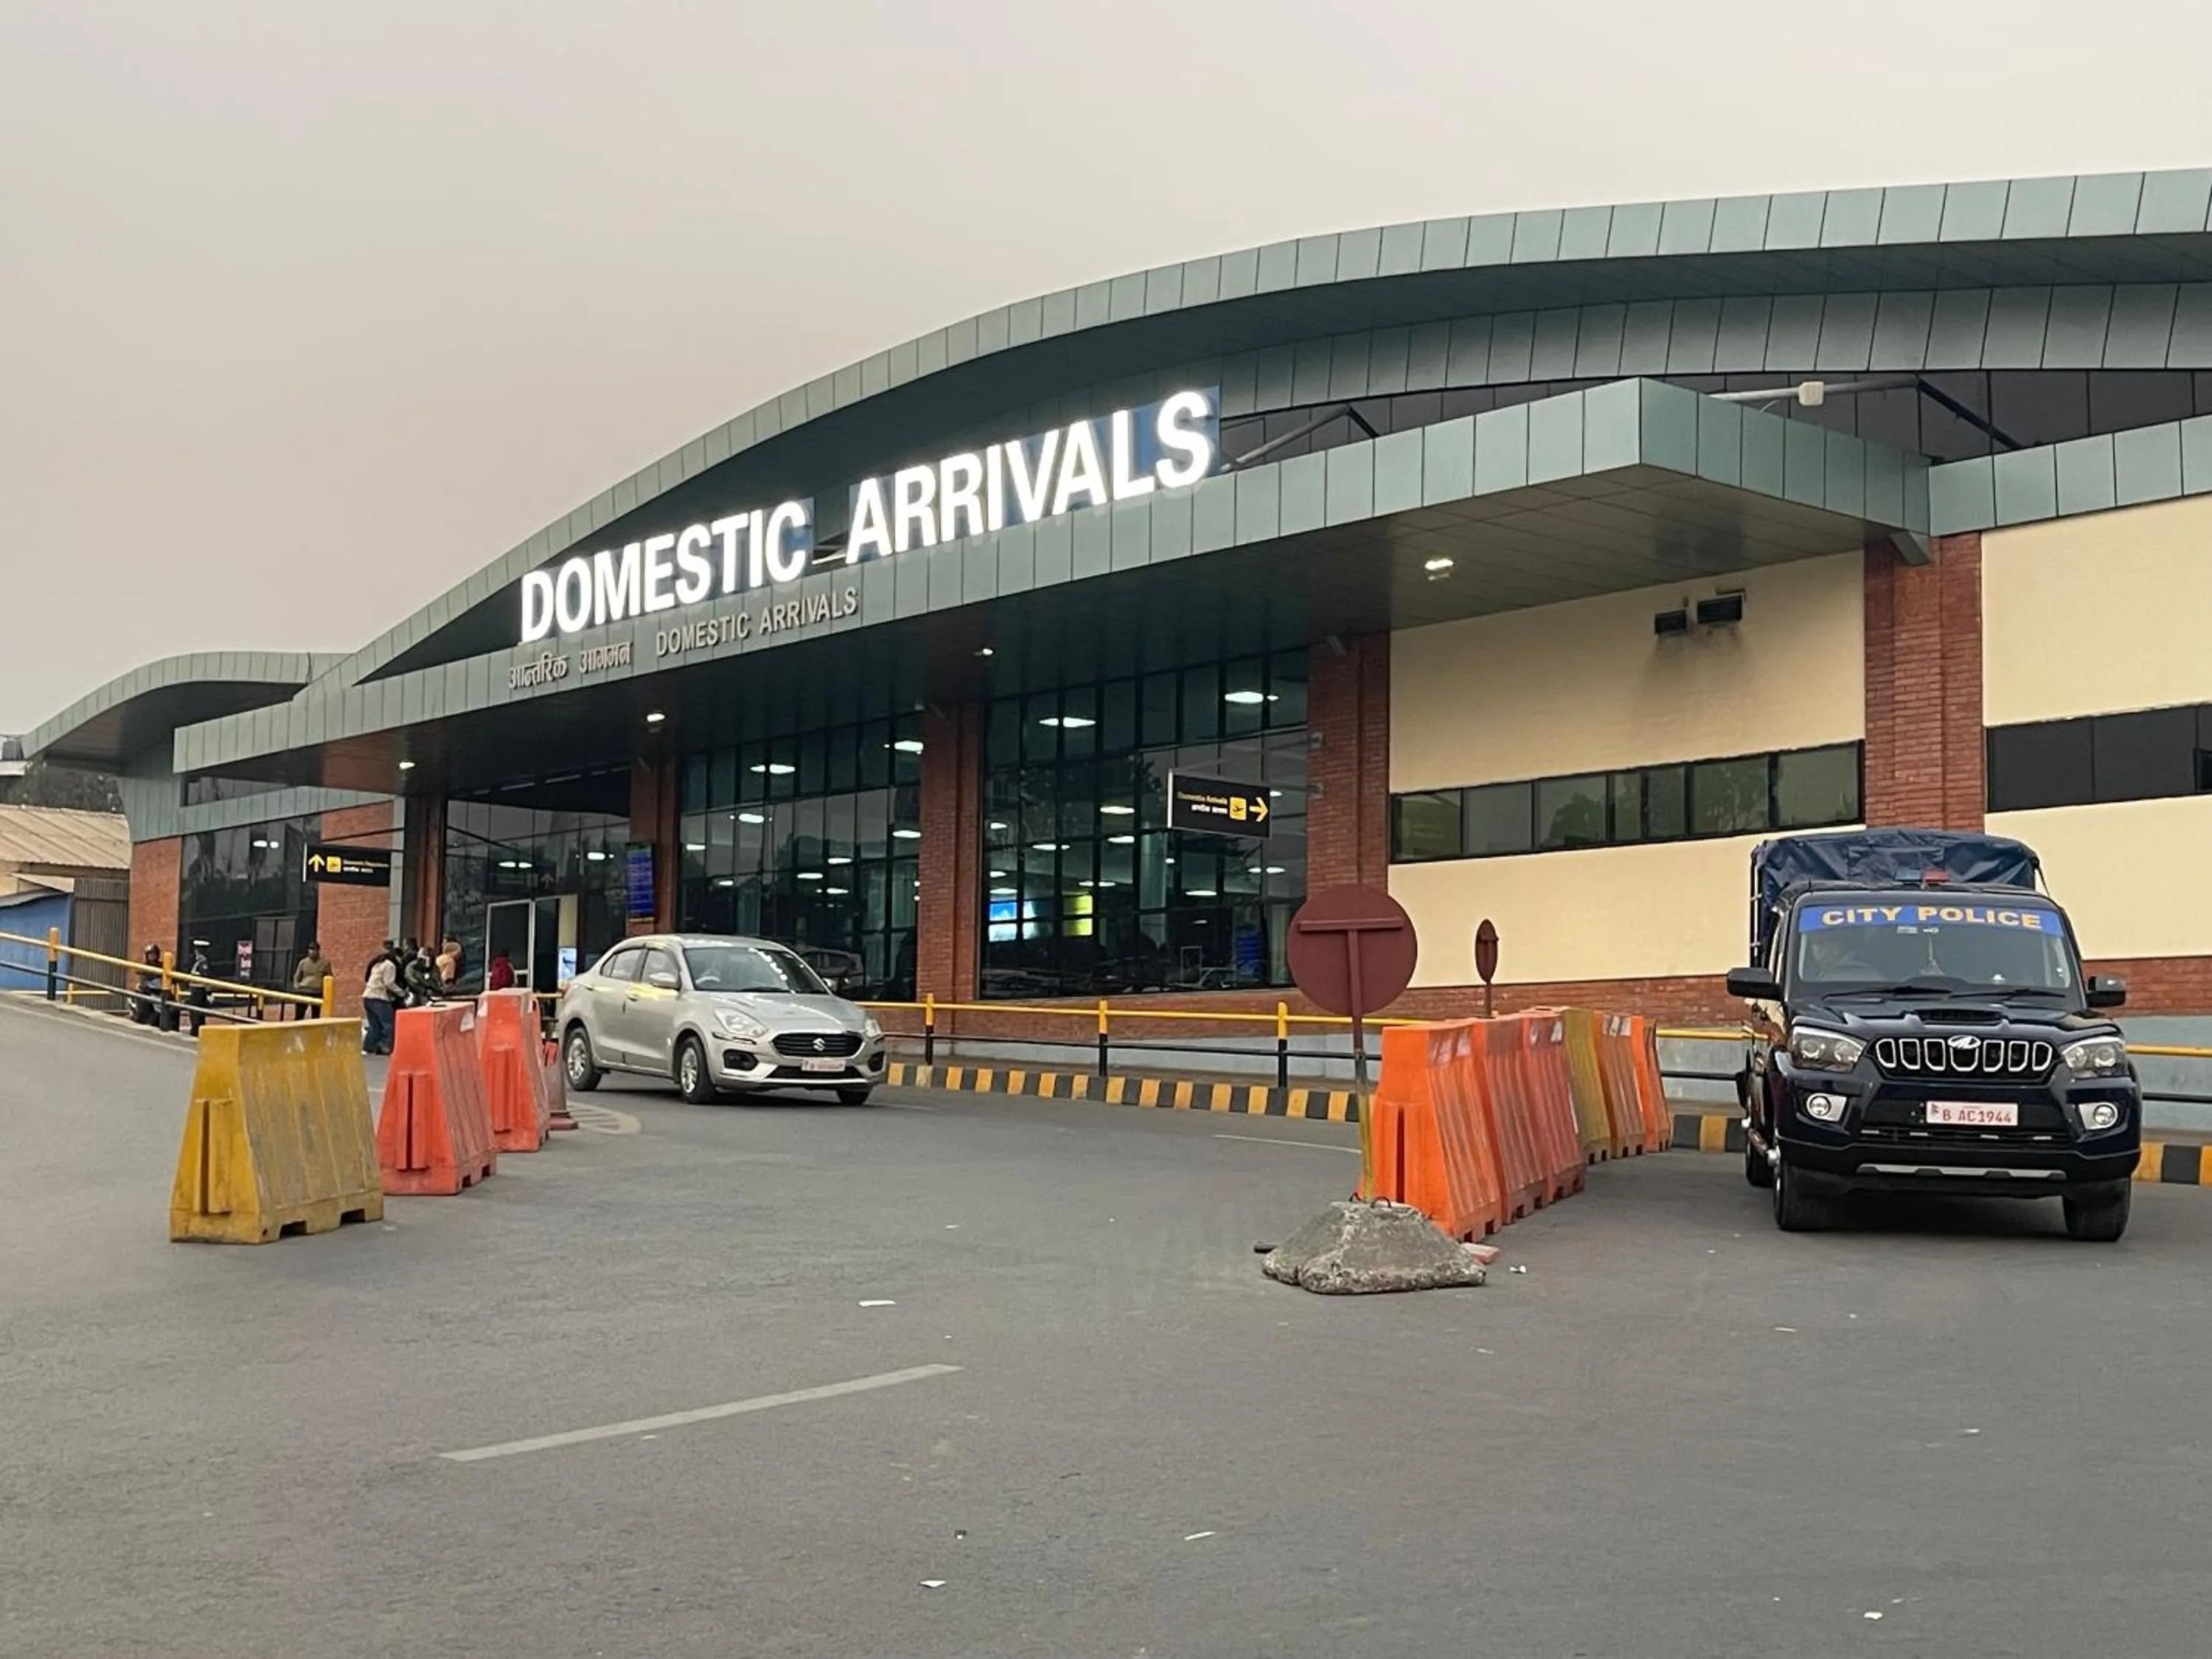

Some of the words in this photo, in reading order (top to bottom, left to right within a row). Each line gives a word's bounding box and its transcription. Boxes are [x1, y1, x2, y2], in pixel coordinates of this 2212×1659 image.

[521, 501, 807, 644] DOMESTIC
[846, 391, 1211, 565] ARRIVALS
[656, 611, 751, 657] DOMESTIC
[759, 586, 858, 636] ARRIVALS
[508, 651, 569, 689] आन्तरिक
[579, 641, 632, 674] आगमन
[1822, 906, 1902, 925] CITY
[1918, 906, 2042, 930] POLICE
